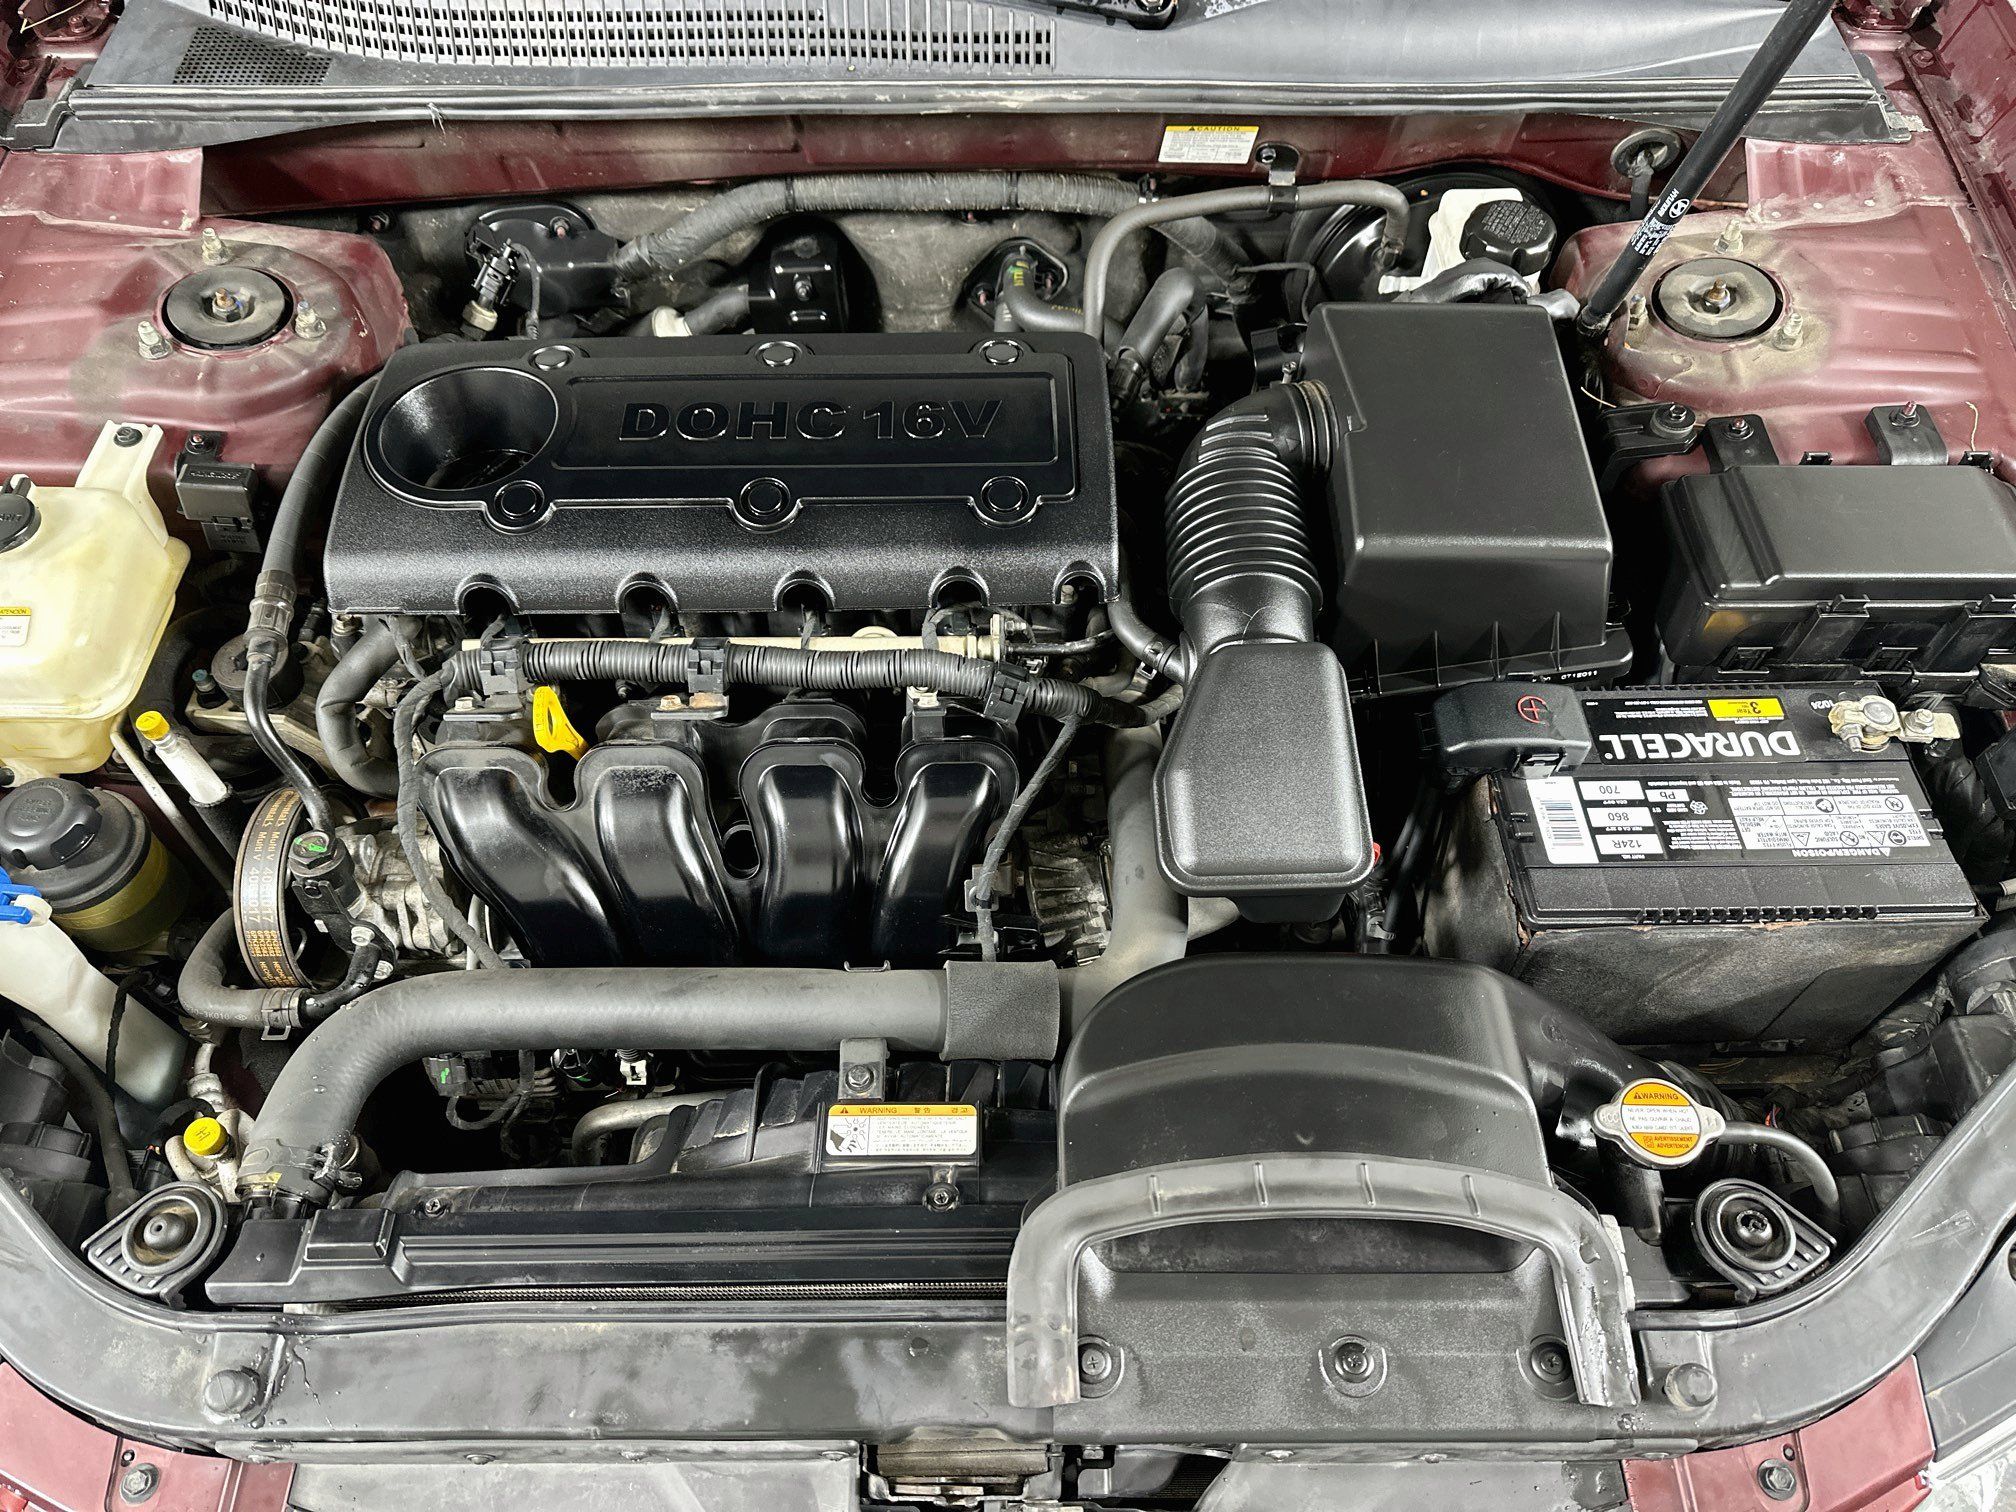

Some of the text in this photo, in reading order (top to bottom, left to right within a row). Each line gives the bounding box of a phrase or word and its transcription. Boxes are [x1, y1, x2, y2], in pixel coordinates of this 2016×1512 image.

[618, 400, 1003, 441] DOHC 16V
[1750, 701, 1762, 714] 3
[1599, 786, 1620, 794] 700
[1608, 812, 1629, 821] 860
[254, 832, 267, 852] Multi
[268, 832, 280, 852] Multi
[1612, 840, 1642, 848] 124R
[1791, 848, 1880, 857] DANGER/POISON
[1643, 1092, 1679, 1100] WARNING
